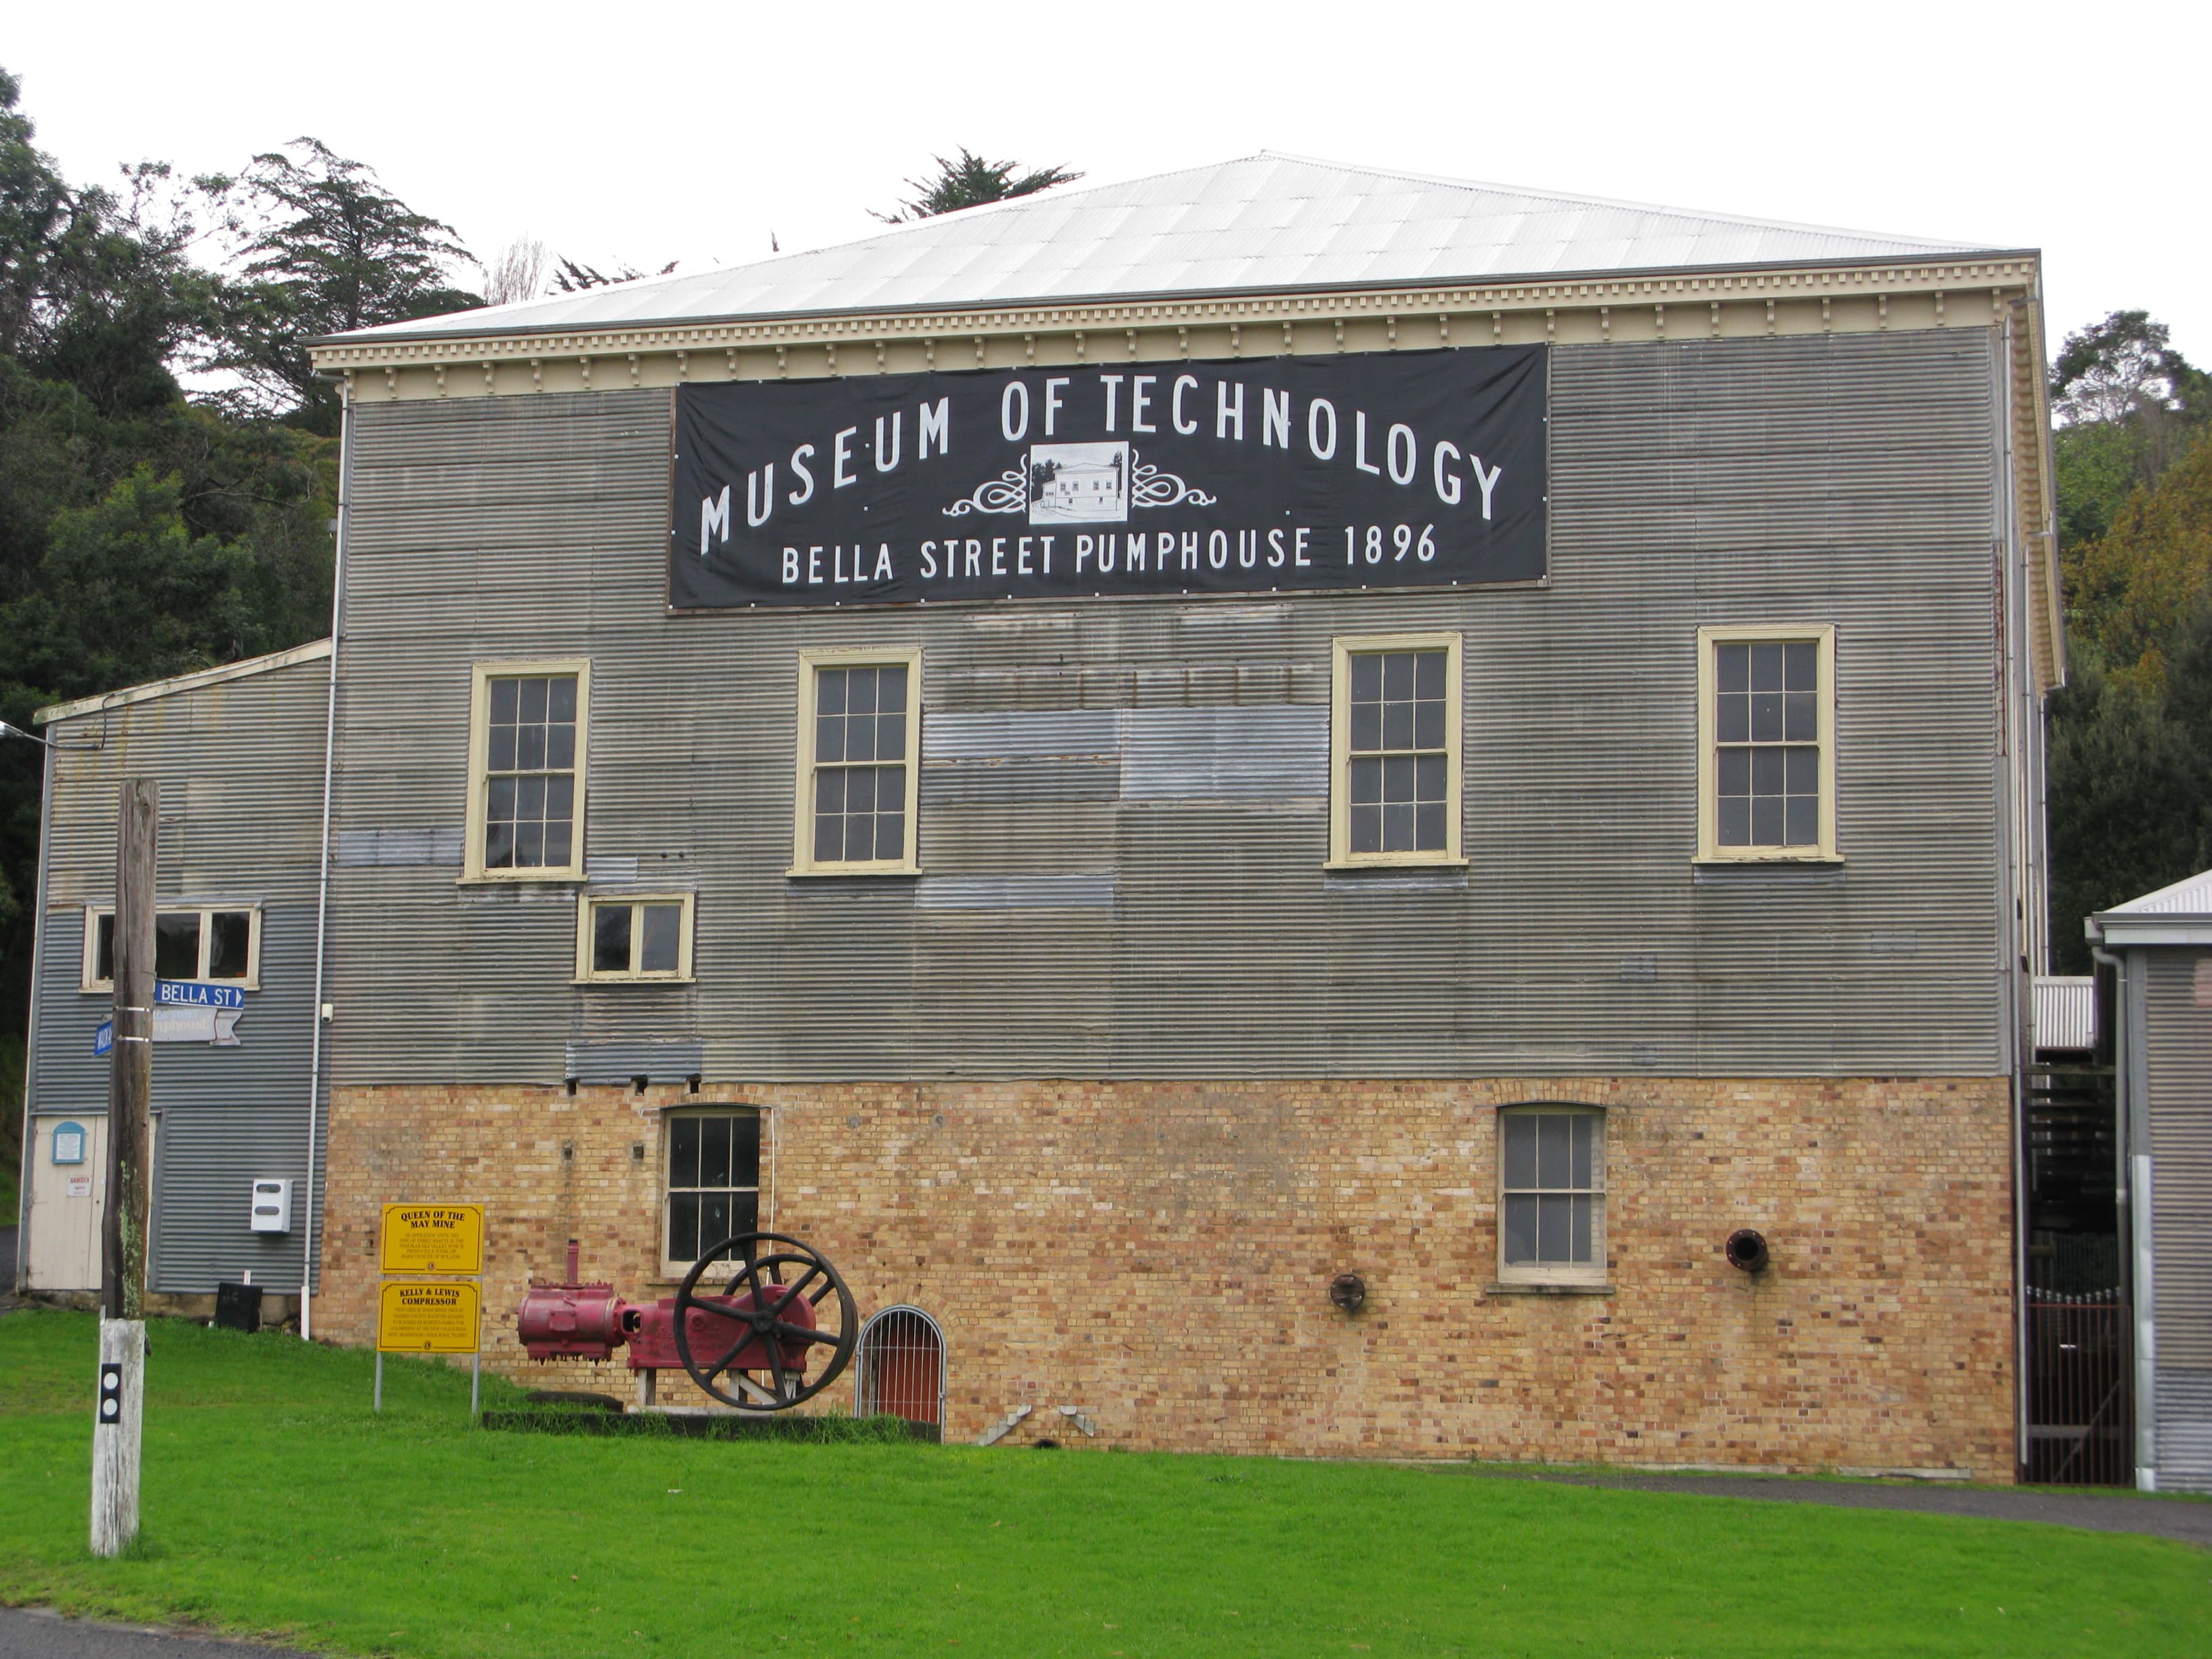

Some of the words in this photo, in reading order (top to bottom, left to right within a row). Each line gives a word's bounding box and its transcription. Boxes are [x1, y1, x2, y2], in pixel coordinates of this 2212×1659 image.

[701, 396, 949, 555] MUSEUM
[1001, 377, 1070, 441] OF
[1099, 374, 1502, 520] TECHNOLOGY
[781, 543, 893, 583] BELLA
[920, 535, 1055, 578] STREET
[1076, 527, 1311, 573] PUMPHOUSE
[1344, 523, 1435, 565] 1896
[161, 984, 208, 1003] BELLA
[214, 988, 232, 1006] ST
[401, 1210, 430, 1221] QUEEN
[447, 1212, 465, 1221] THE
[410, 1220, 430, 1228] MAY
[432, 1221, 455, 1229] MINE
[400, 1288, 424, 1297] KELLY
[434, 1288, 460, 1297] LEWIS
